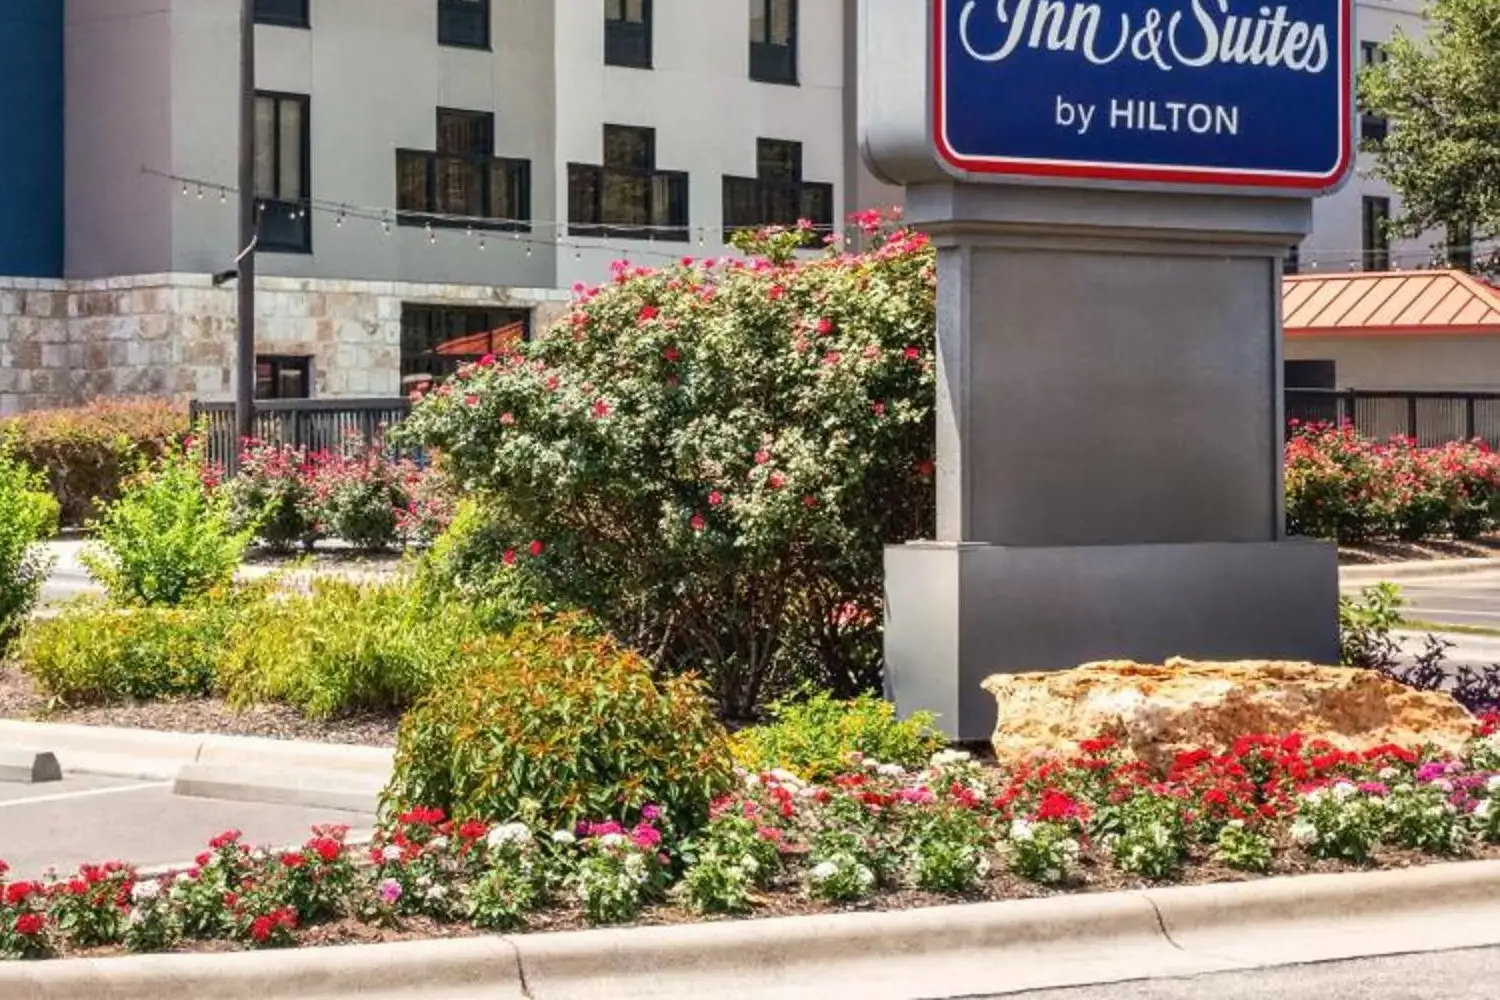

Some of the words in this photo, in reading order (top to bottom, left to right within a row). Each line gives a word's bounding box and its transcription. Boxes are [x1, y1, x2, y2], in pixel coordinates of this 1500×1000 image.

[1131, 8, 1173, 71] &
[1055, 95, 1097, 135] by
[1109, 98, 1239, 135] HILTON
